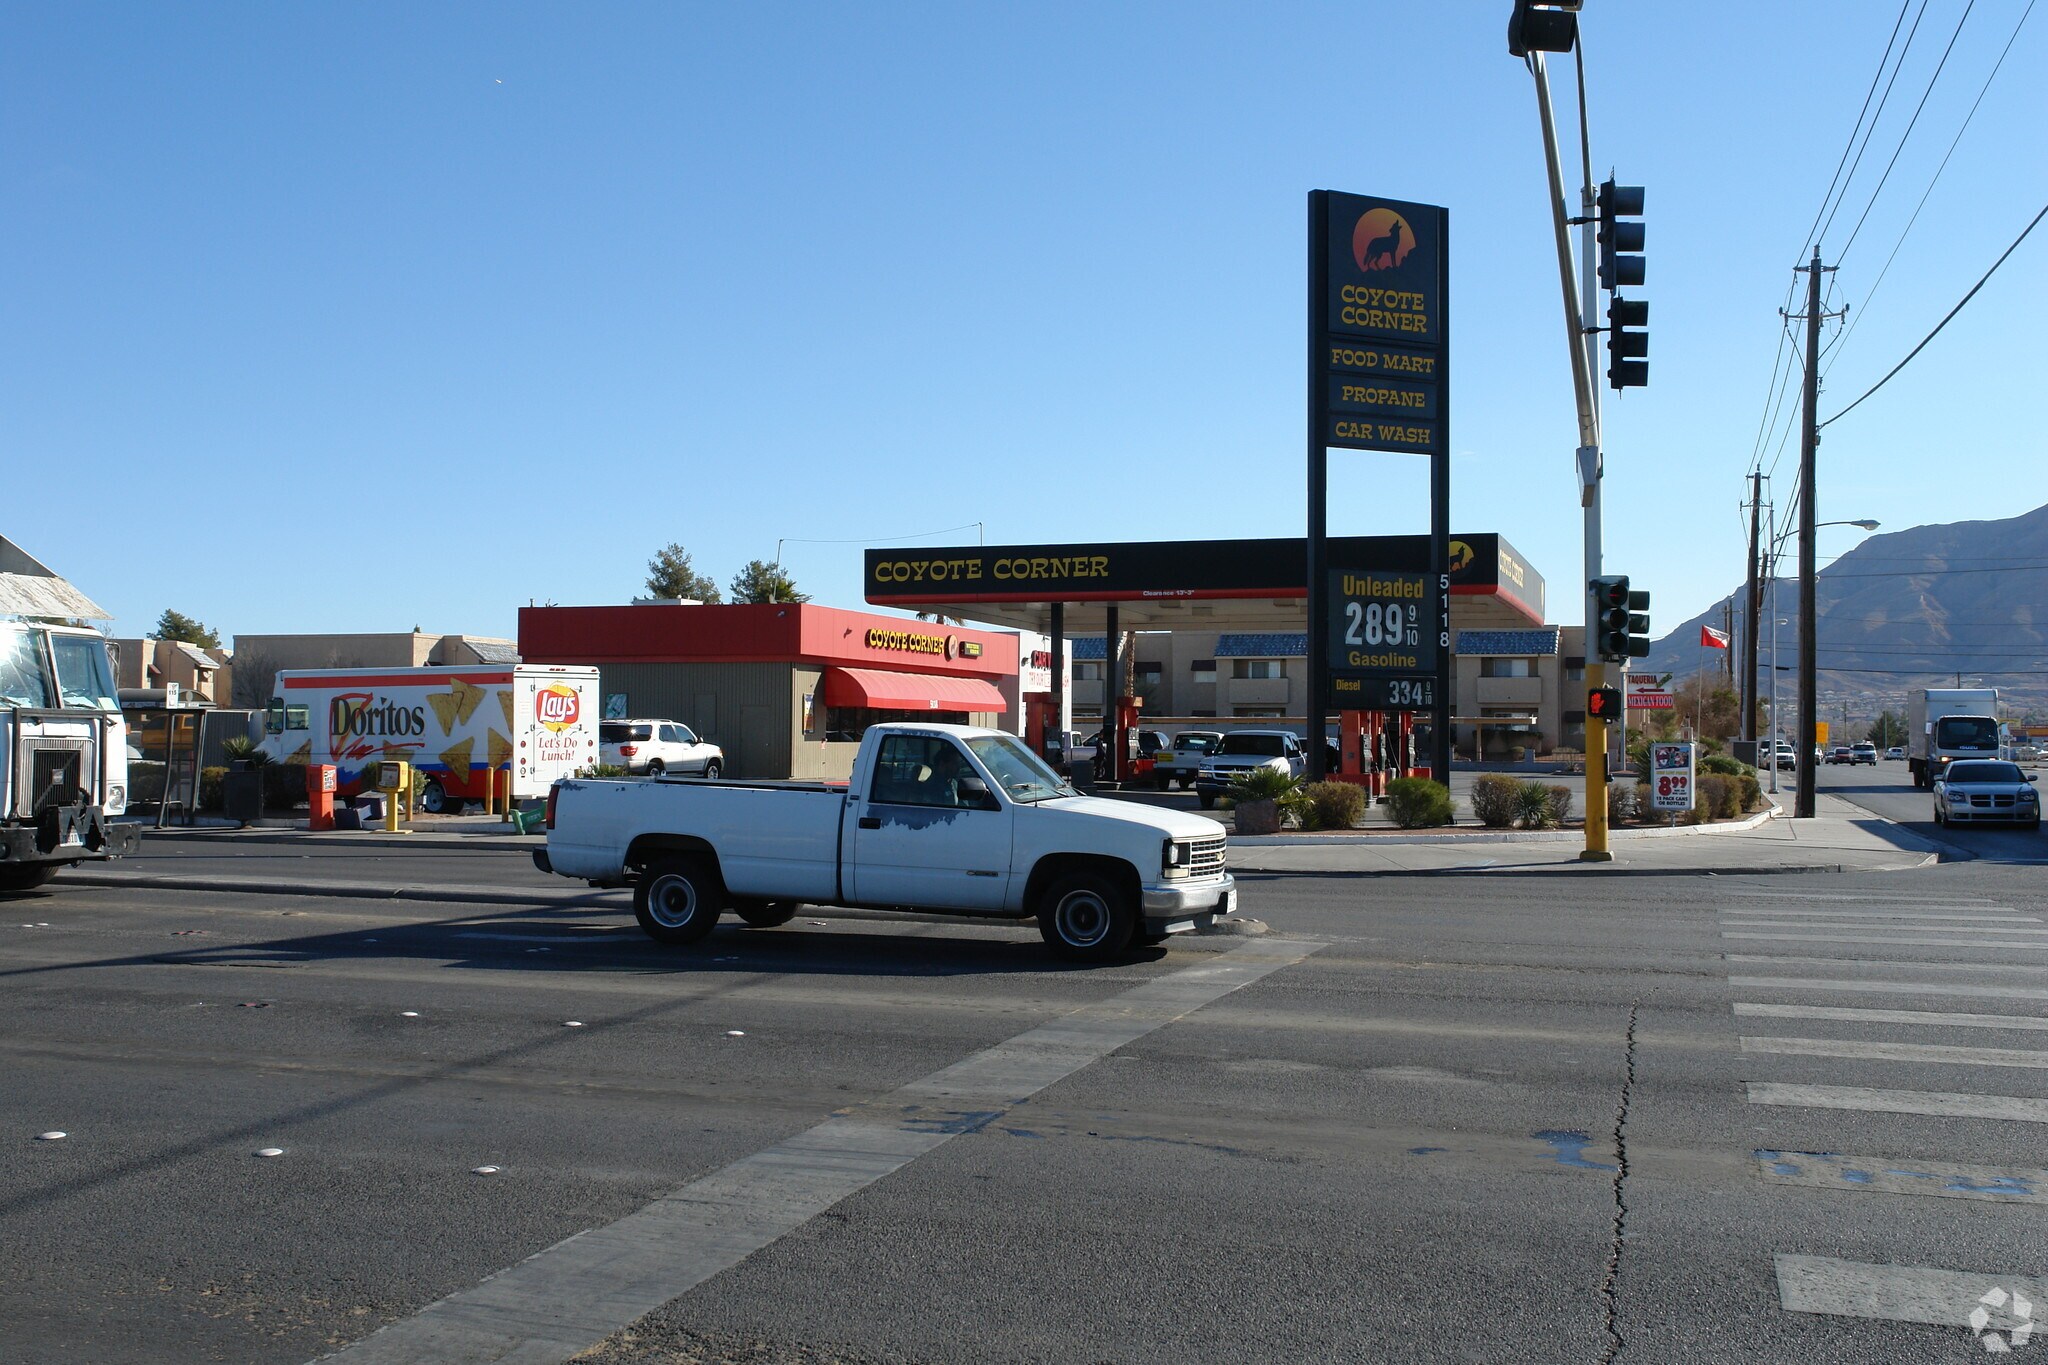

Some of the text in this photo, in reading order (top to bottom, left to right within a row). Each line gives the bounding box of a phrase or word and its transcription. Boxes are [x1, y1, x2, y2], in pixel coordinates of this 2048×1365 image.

[1341, 285, 1424, 311] COYOTE
[1341, 306, 1427, 333] CORNER
[1332, 349, 1434, 373] FOOD MART
[1342, 386, 1425, 407] PROPANE
[1335, 421, 1430, 444] CAR WASH
[875, 556, 1109, 582] COYOTE CORNER
[1343, 575, 1424, 598] Unleaded
[1345, 602, 1403, 645] 289
[869, 628, 945, 654] COYOTE CORNER
[1349, 651, 1417, 668] Gasoline
[1336, 679, 1360, 691] Diesel
[1389, 680, 1423, 705] 334
[1628, 675, 1658, 685] TAQUERIA
[539, 691, 576, 722] Lay's
[1628, 696, 1673, 707] MEXICAN FOOD
[331, 696, 425, 737] Doritos
[538, 737, 578, 748] Let's Do
[541, 750, 575, 761] Lunch!
